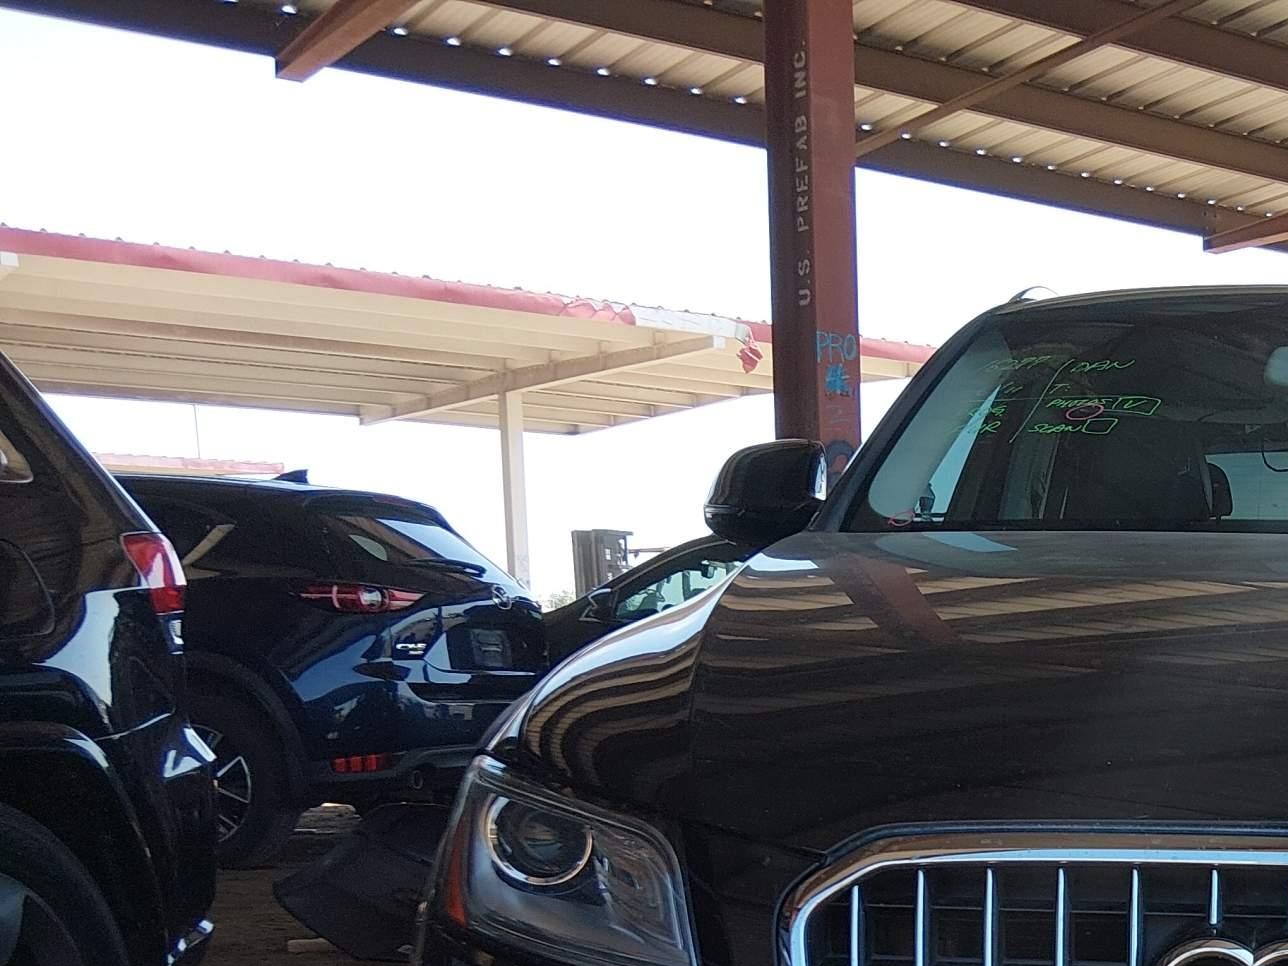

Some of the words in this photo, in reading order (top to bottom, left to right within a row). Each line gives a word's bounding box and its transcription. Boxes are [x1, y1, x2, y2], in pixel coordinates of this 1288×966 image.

[793, 41, 807, 102] INC.
[796, 116, 811, 233] PREFAB
[797, 249, 812, 306] U.S.
[816, 331, 857, 363] PRO
